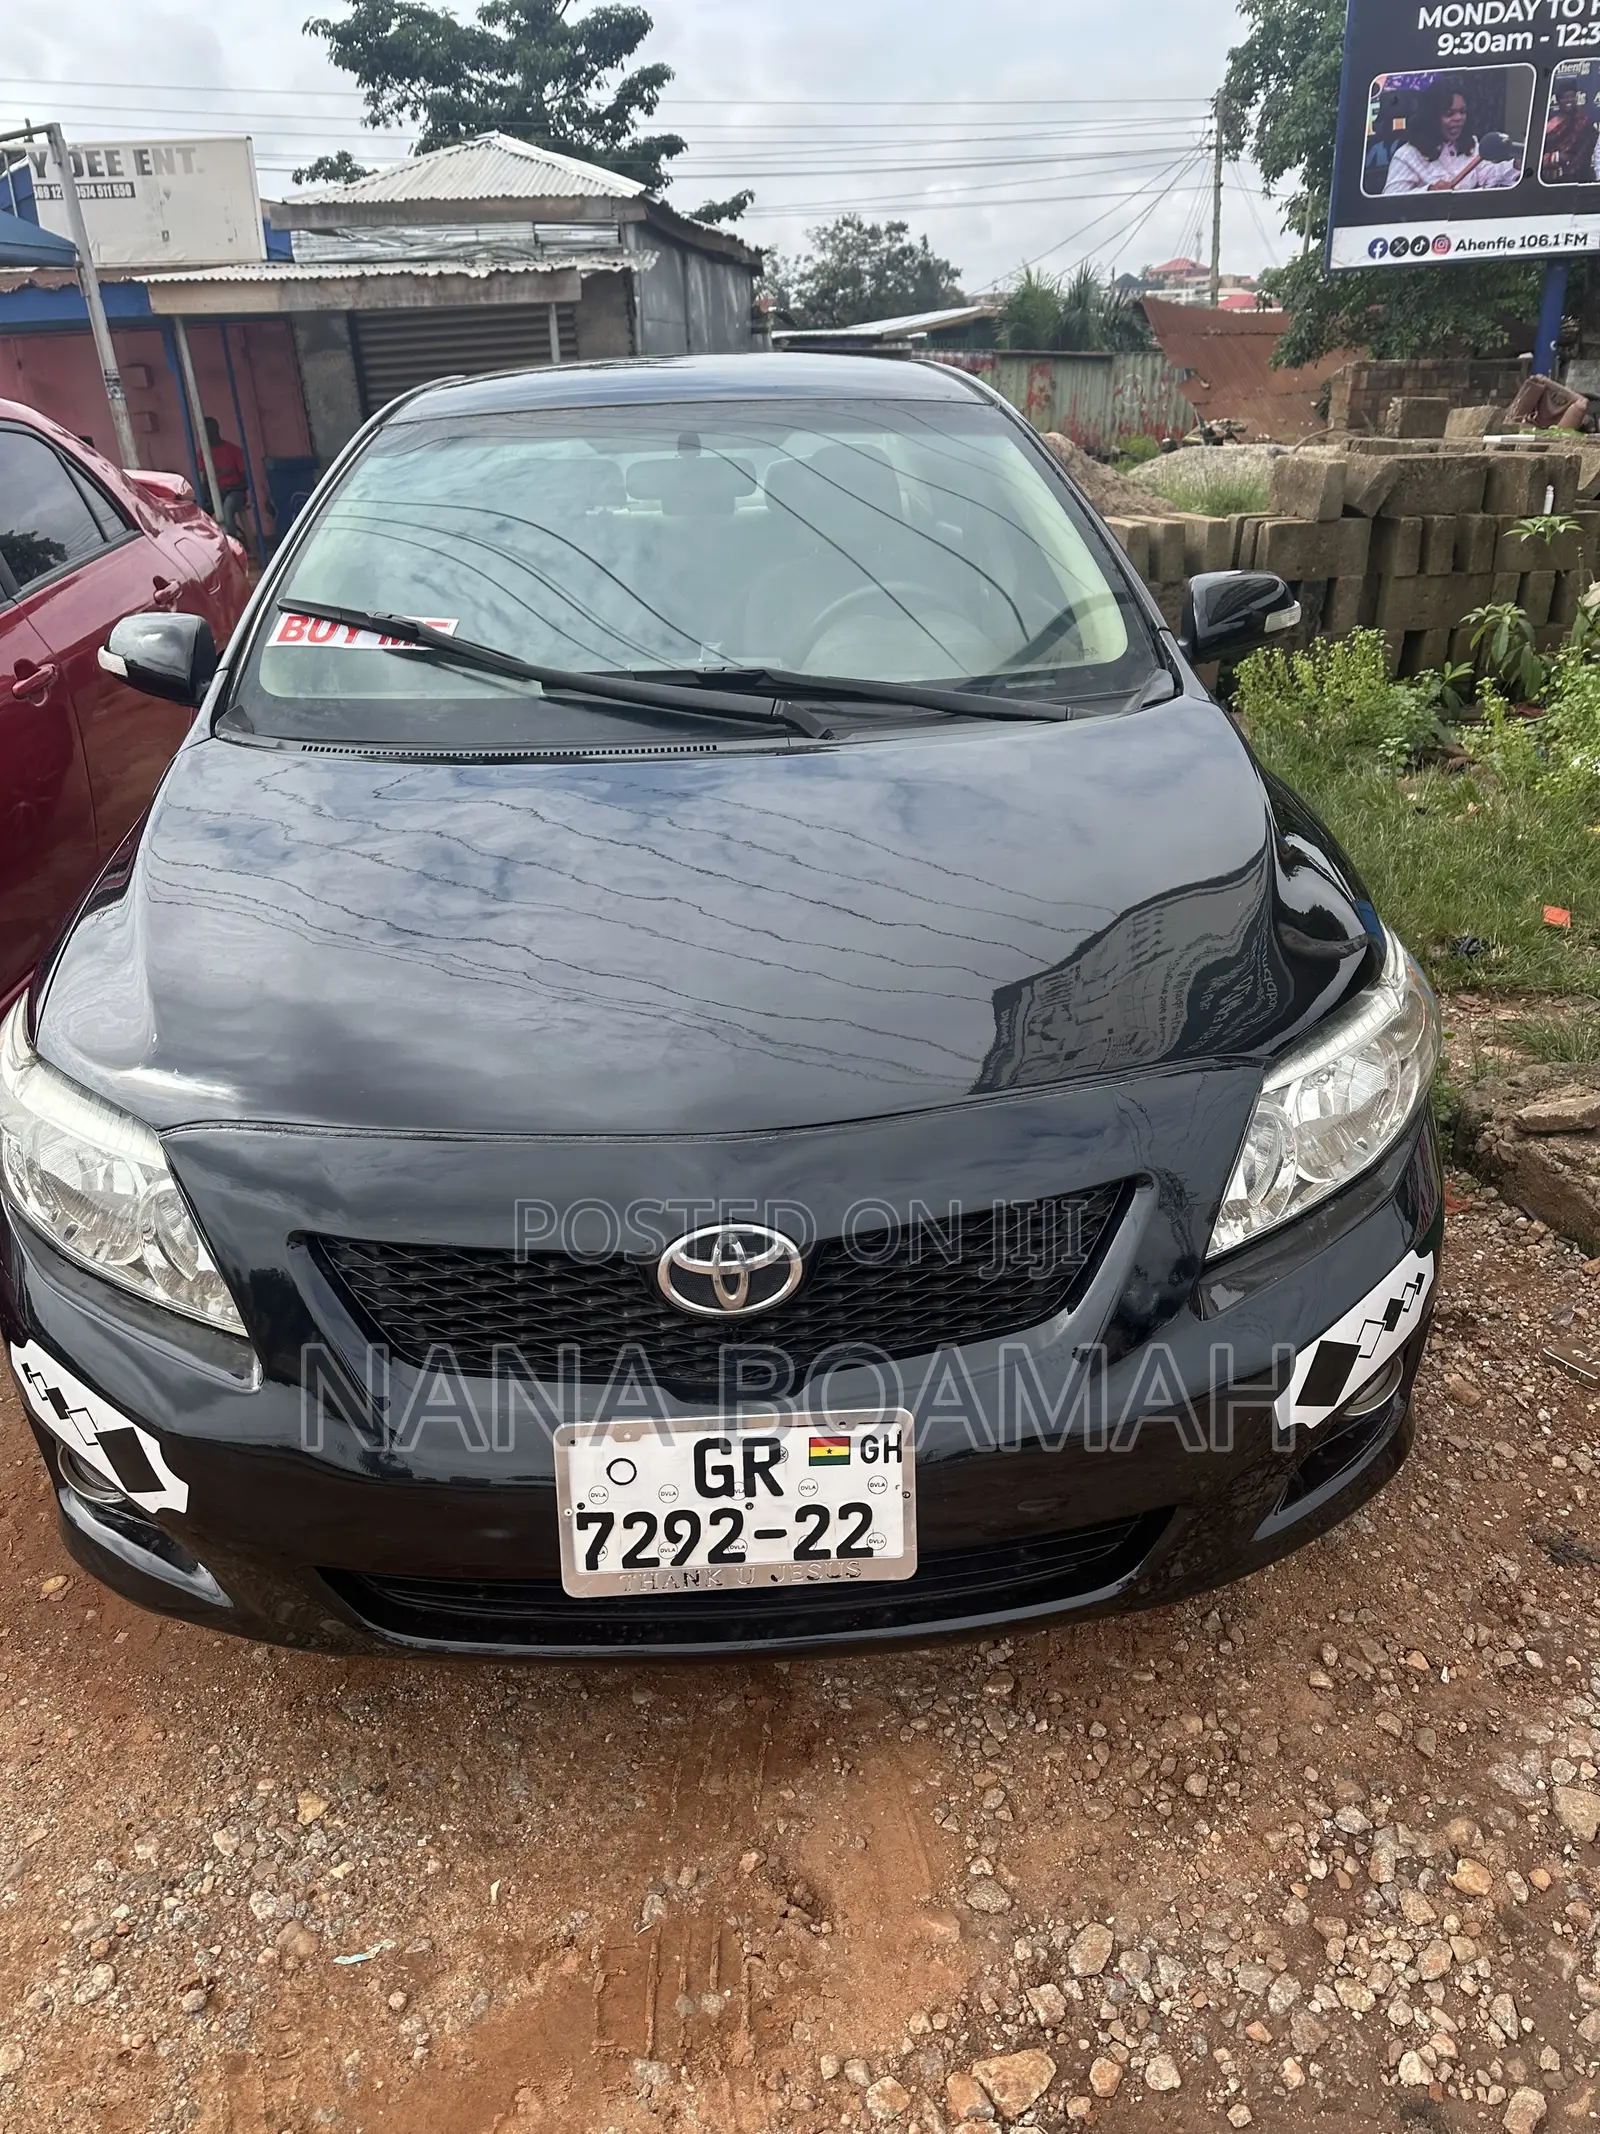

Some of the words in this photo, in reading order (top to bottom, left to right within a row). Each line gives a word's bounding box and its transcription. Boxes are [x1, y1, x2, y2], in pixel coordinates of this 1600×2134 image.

[1418, 0, 1541, 30] MONDAY
[1547, 0, 1585, 19] TO
[1437, 31, 1534, 56] 9:30am
[132, 147, 205, 176] ENT.
[1455, 236, 1516, 252] Ahenfie
[1519, 233, 1562, 248] 106.1
[1564, 233, 1588, 247] FM
[277, 615, 362, 644] BUY
[693, 1437, 785, 1499] GR
[860, 1433, 903, 1464] GH
[576, 1502, 874, 1570] 7292-22
[619, 1568, 723, 1593] THANK
[735, 1567, 755, 1585] U
[770, 1562, 861, 1583] JESUS
